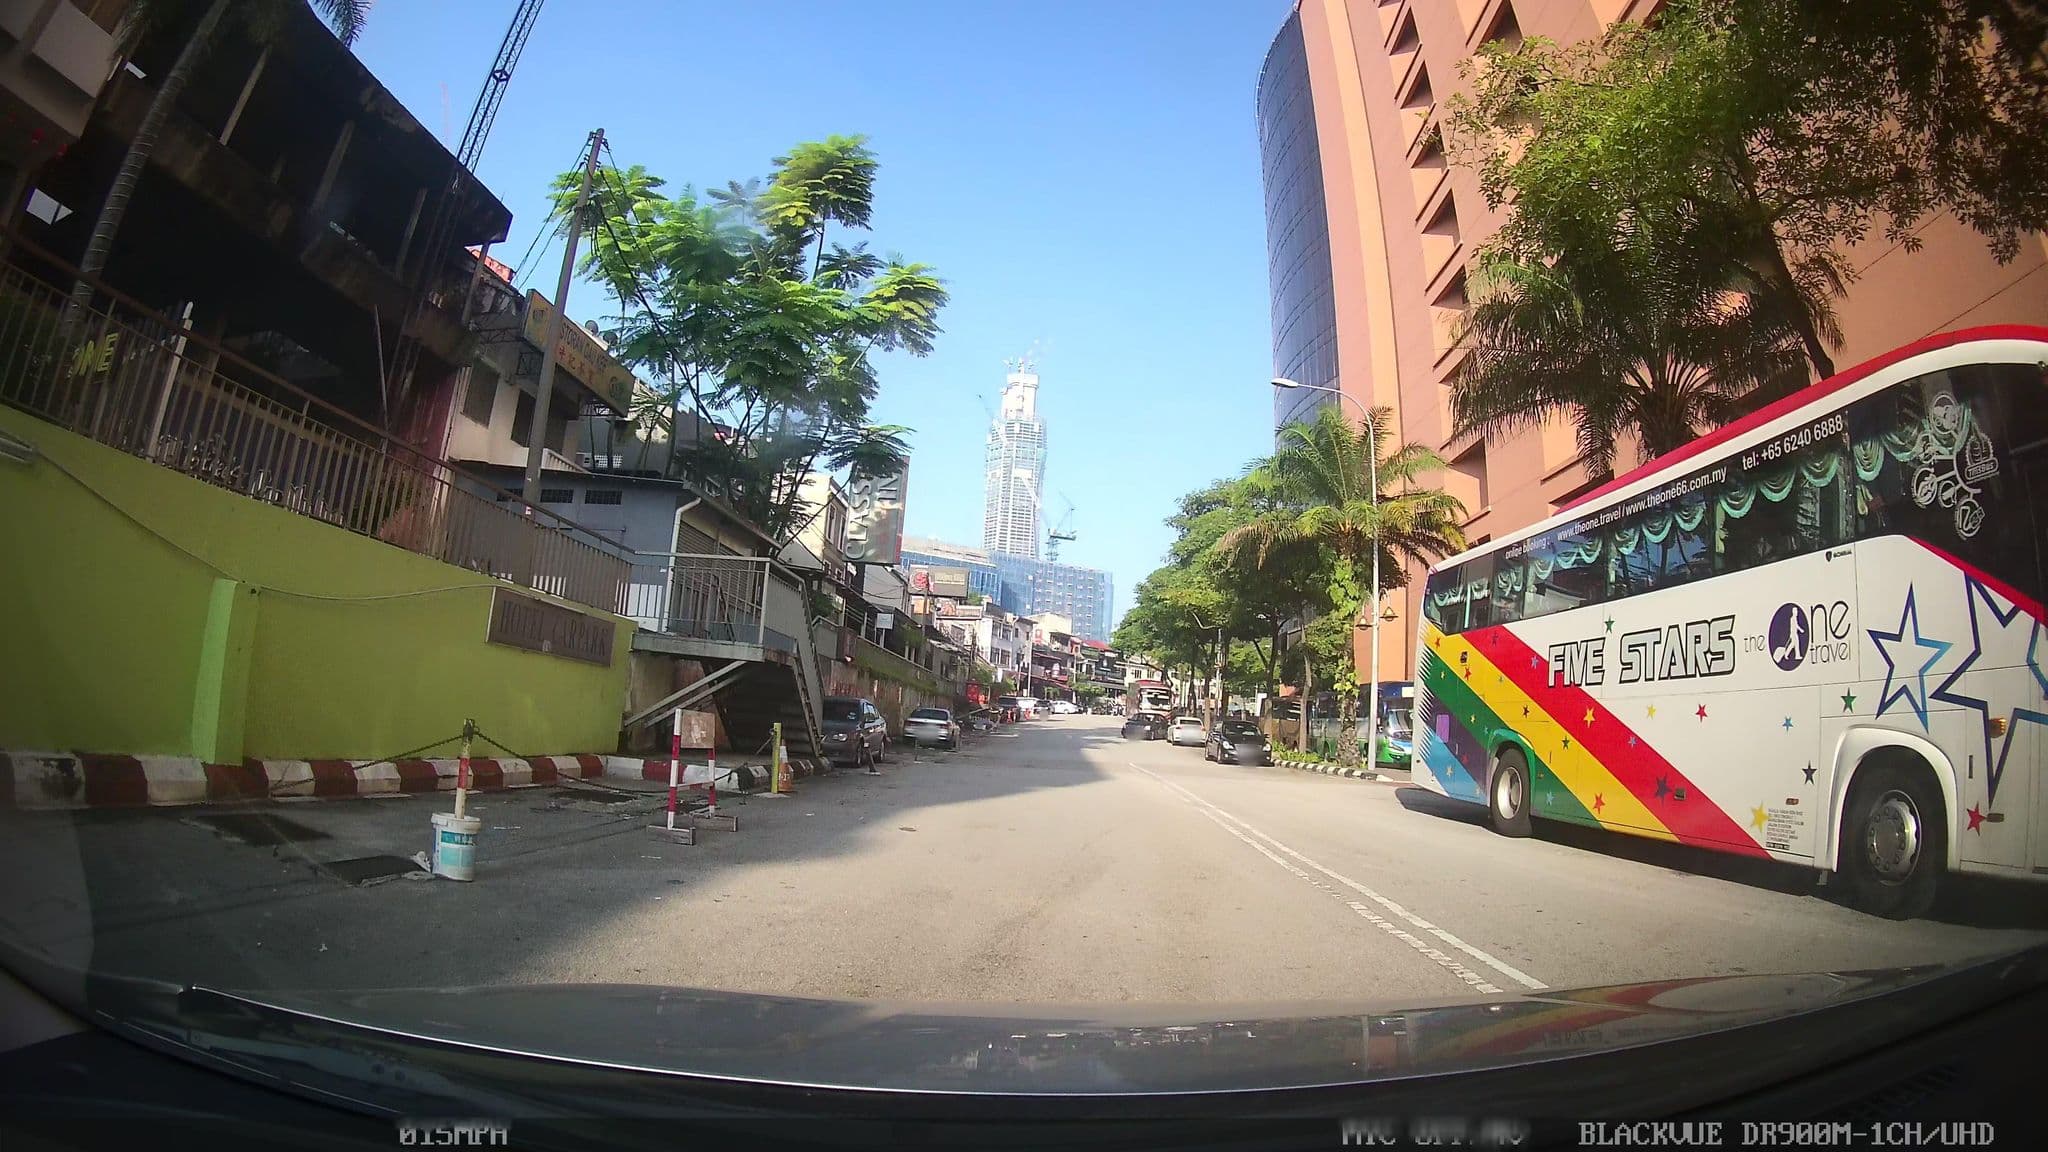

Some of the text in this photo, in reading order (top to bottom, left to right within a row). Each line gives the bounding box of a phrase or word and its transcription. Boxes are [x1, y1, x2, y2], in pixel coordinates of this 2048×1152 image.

[1742, 414, 1843, 470] tel: +65 6240 6888
[845, 479, 871, 560] CLASS
[500, 600, 608, 657] HOTEL CARPARK
[1548, 614, 1736, 688] FIVE STARS
[1743, 631, 1766, 653] the
[1810, 641, 1852, 664] travel
